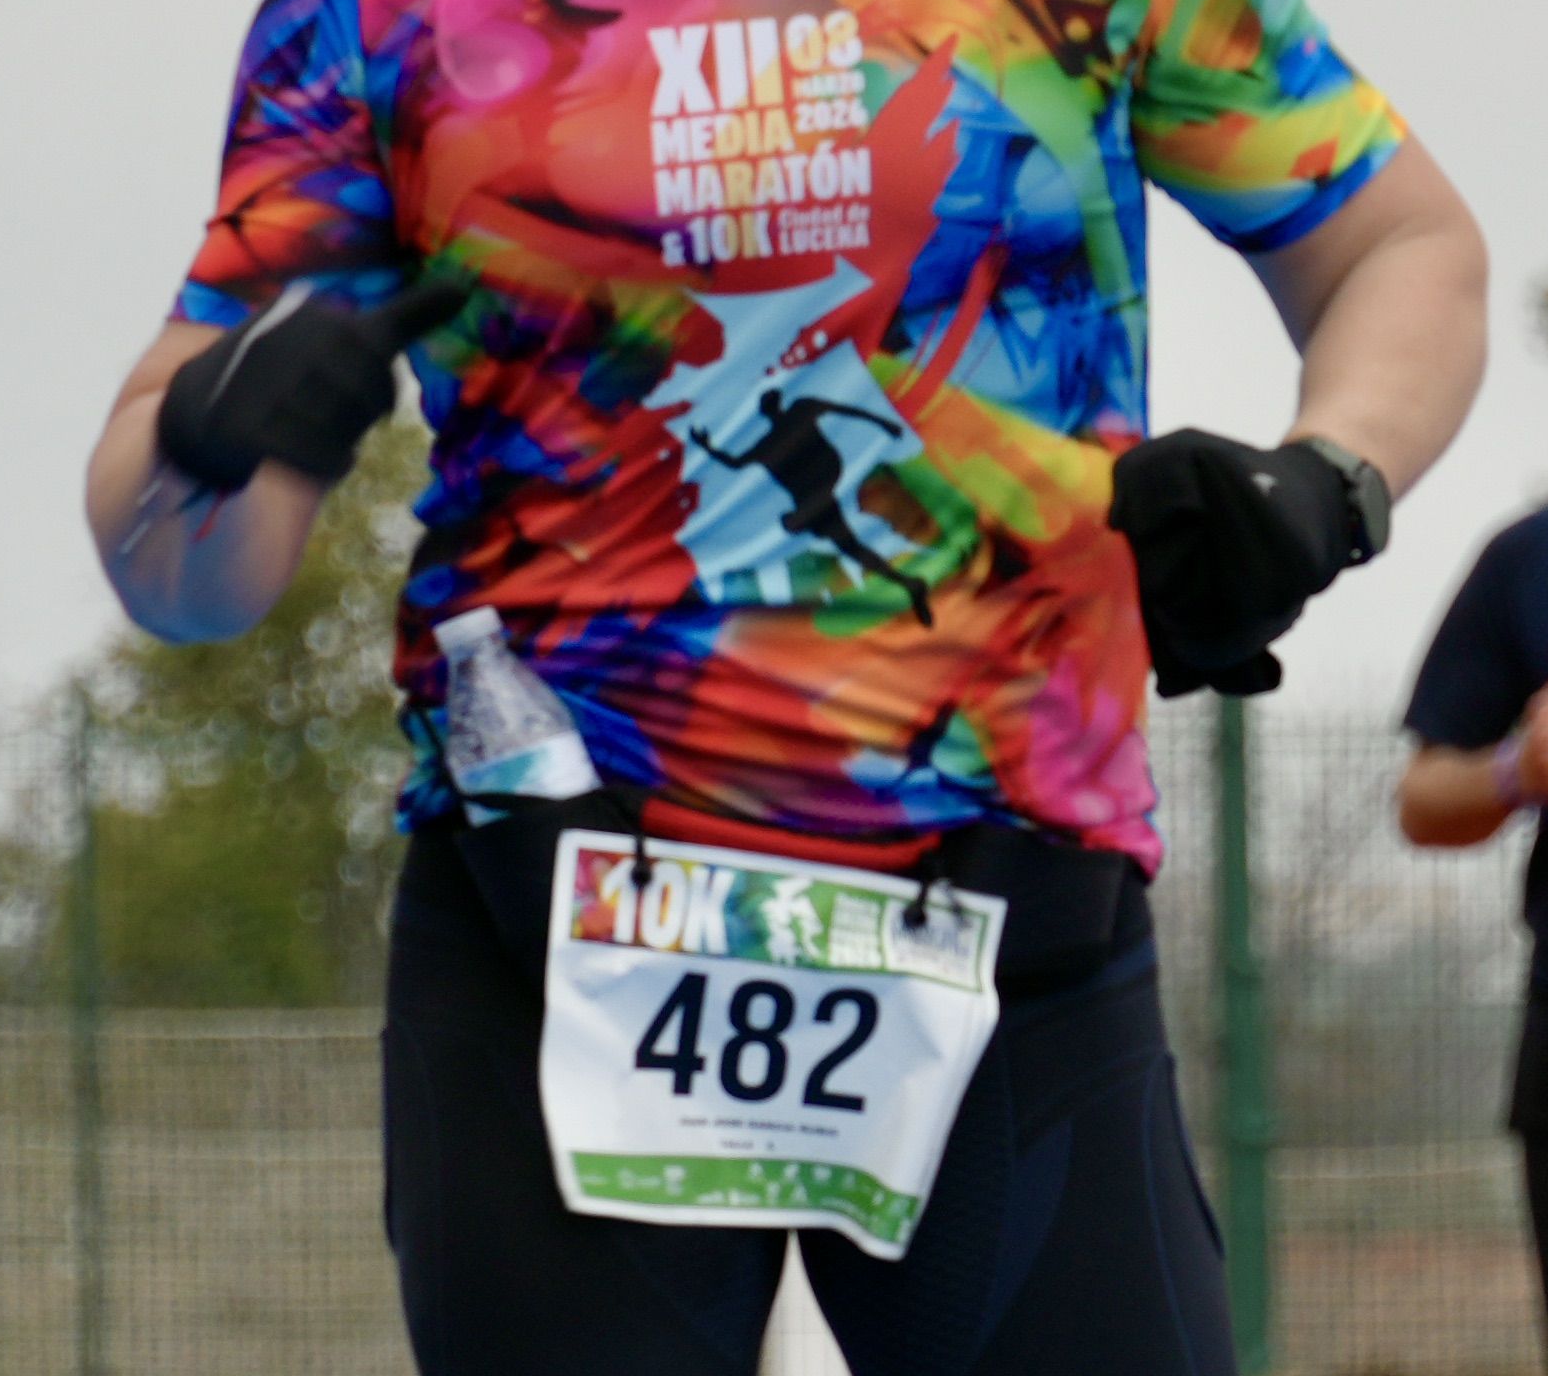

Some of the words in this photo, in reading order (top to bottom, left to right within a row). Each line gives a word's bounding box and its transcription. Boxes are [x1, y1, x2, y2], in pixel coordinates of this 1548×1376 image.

[648, 17, 785, 117] XII
[652, 108, 795, 166] MEDIA
[654, 140, 872, 217] MARATÓN
[660, 231, 685, 267] &
[689, 210, 775, 264] 10K
[779, 223, 870, 256] LUCENA
[601, 856, 736, 955] 10K
[634, 971, 880, 1114] 482
